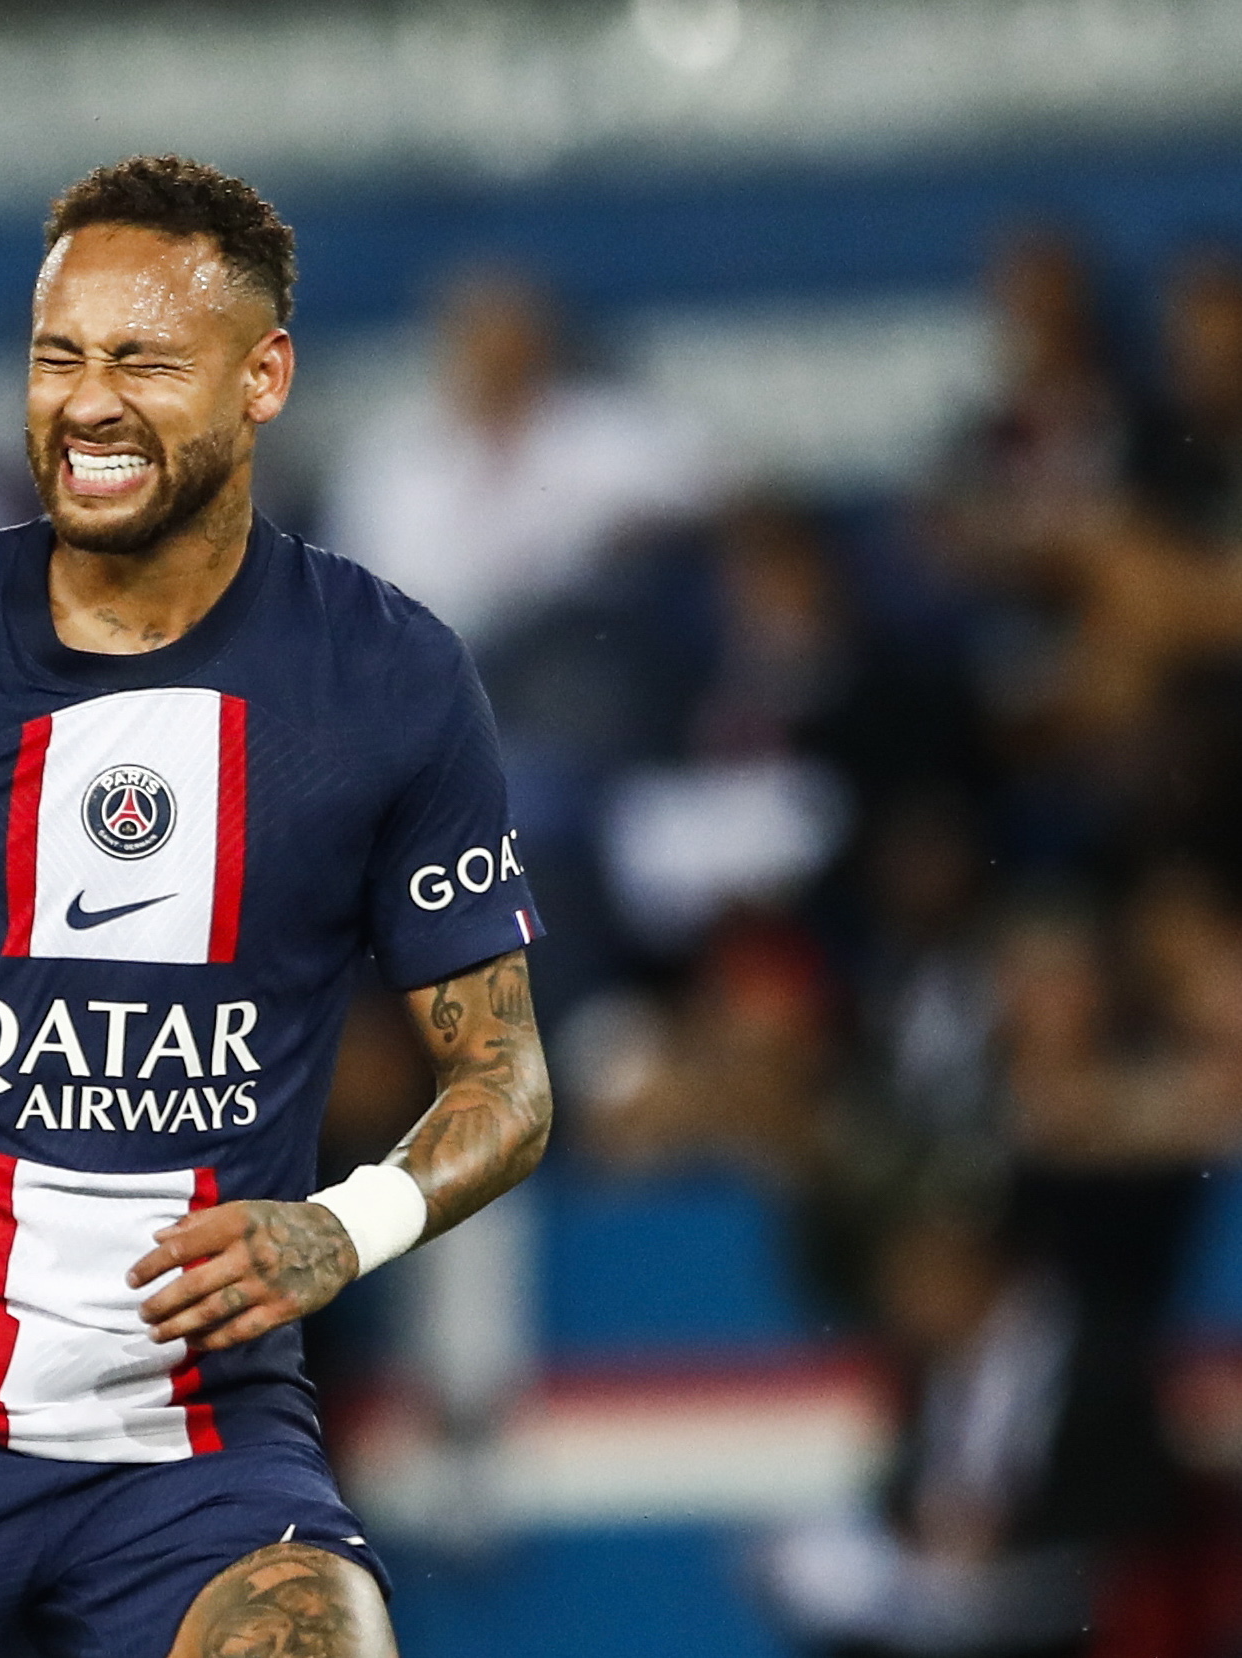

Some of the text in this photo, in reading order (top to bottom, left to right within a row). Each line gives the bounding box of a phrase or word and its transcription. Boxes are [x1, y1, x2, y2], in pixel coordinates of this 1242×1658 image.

[99, 771, 161, 796] PARIS
[409, 828, 525, 912] GOA
[14, 1080, 257, 1134] AIRWAYS
